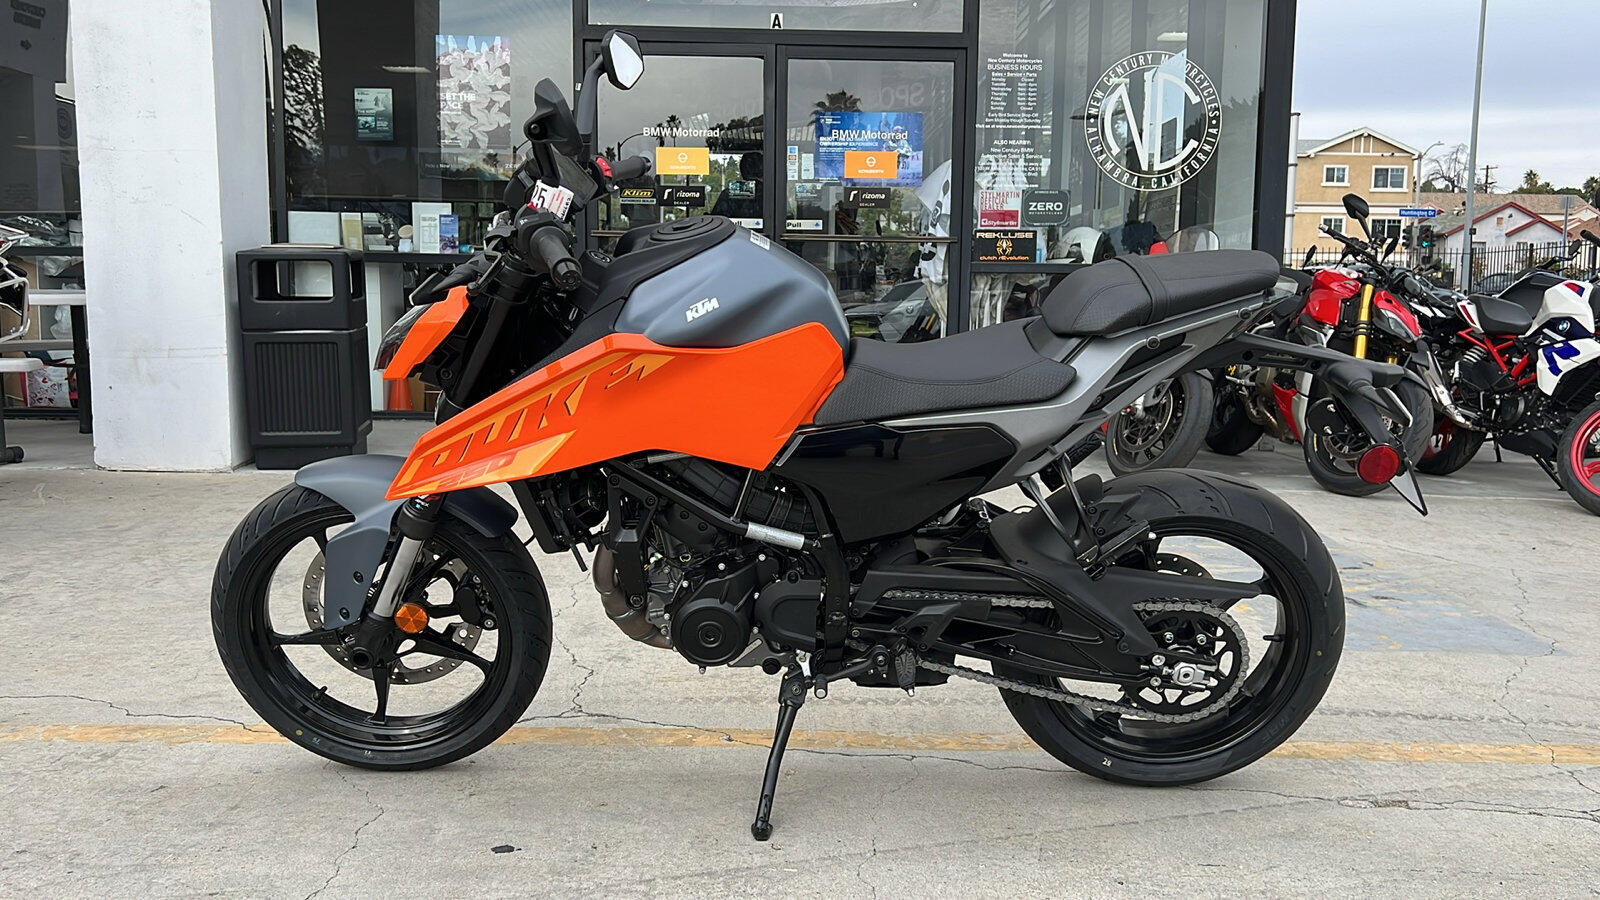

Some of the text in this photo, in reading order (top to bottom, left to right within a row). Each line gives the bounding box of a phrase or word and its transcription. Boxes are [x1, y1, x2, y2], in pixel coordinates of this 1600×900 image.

[771, 14, 782, 29] A
[1088, 54, 1220, 117] NEW CENTURY MORCYCLES
[440, 102, 464, 110] PACE
[642, 127, 720, 137] BMW Motorrad
[832, 130, 908, 140] BMW Motorrad
[1151, 128, 1219, 188] CALIFORNIA
[624, 189, 652, 197] Klim
[862, 190, 885, 199] rizoma
[1029, 202, 1063, 211] ZERO
[685, 297, 720, 322] KTM
[396, 353, 676, 487] DUKE
